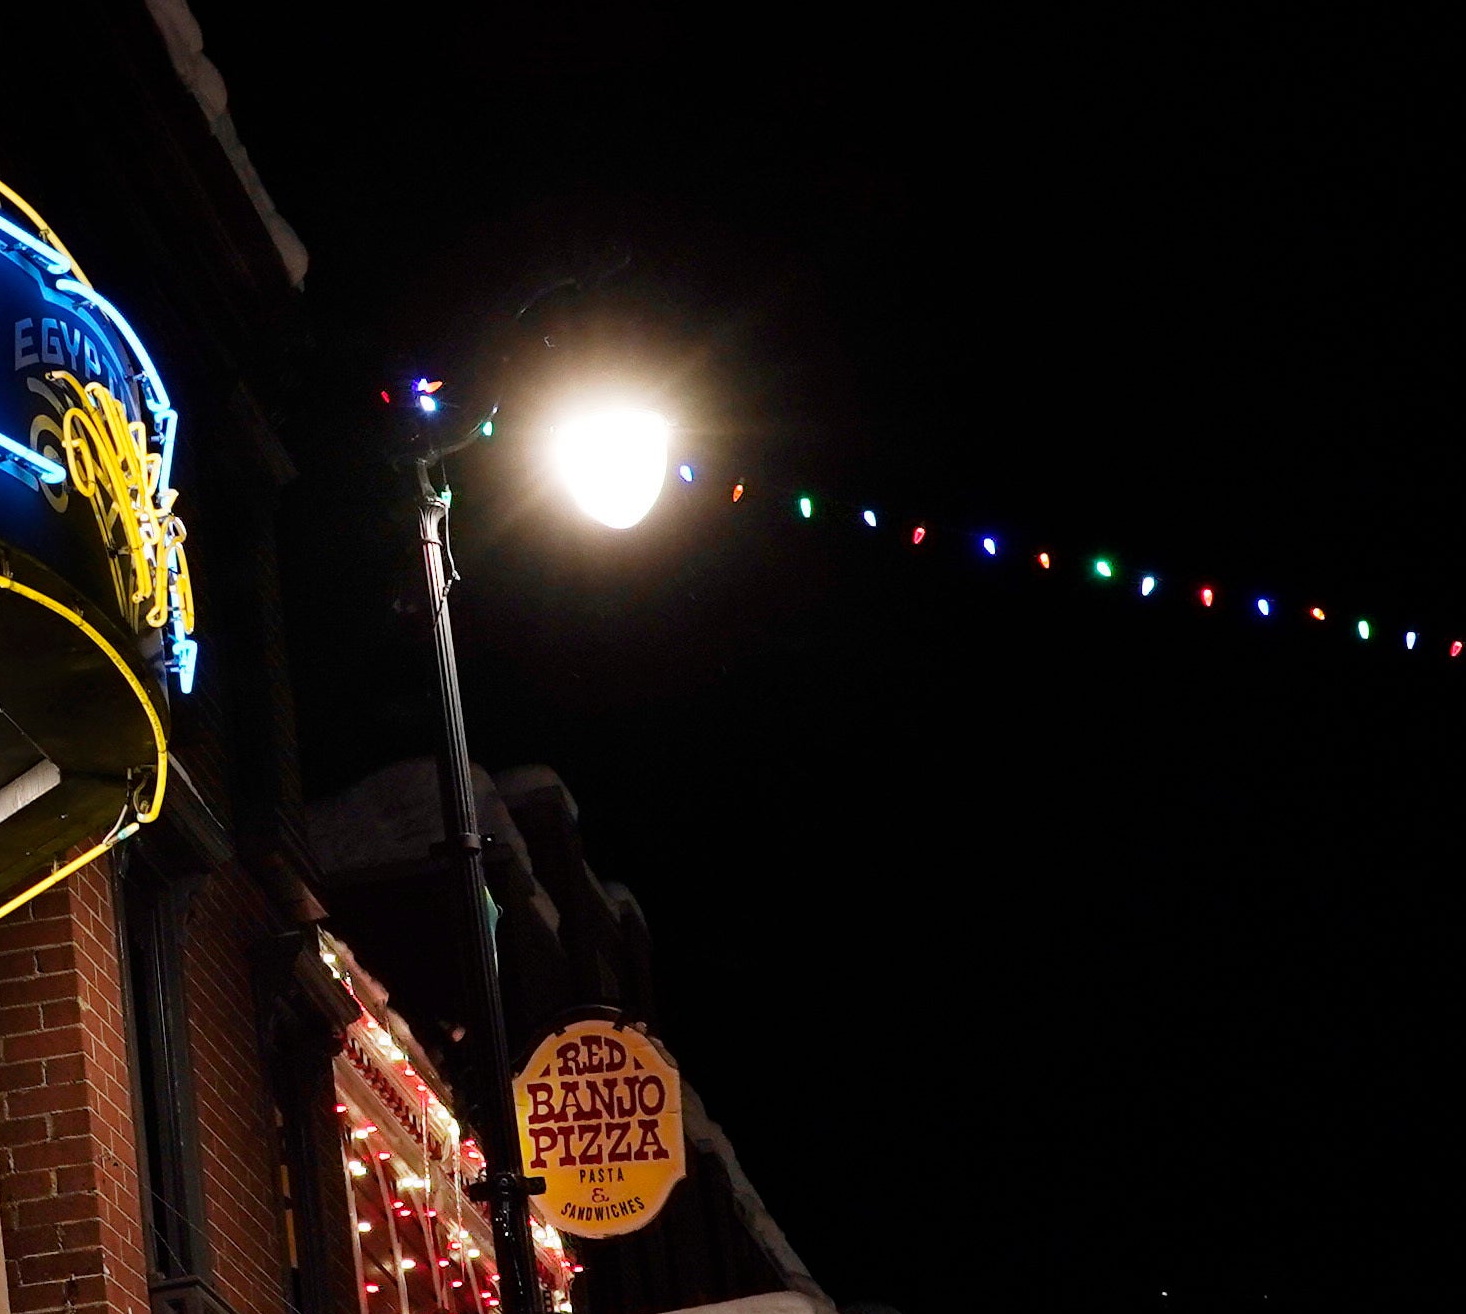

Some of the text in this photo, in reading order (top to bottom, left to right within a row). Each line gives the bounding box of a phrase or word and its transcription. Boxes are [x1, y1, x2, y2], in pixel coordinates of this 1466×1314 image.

[556, 1034, 626, 1076] RED
[527, 1075, 666, 1124] BANJO
[529, 1119, 670, 1168] PIZZA
[579, 1167, 625, 1183] PASTA
[561, 1196, 645, 1221] SANDWICHES
[591, 1188, 609, 1203] &
